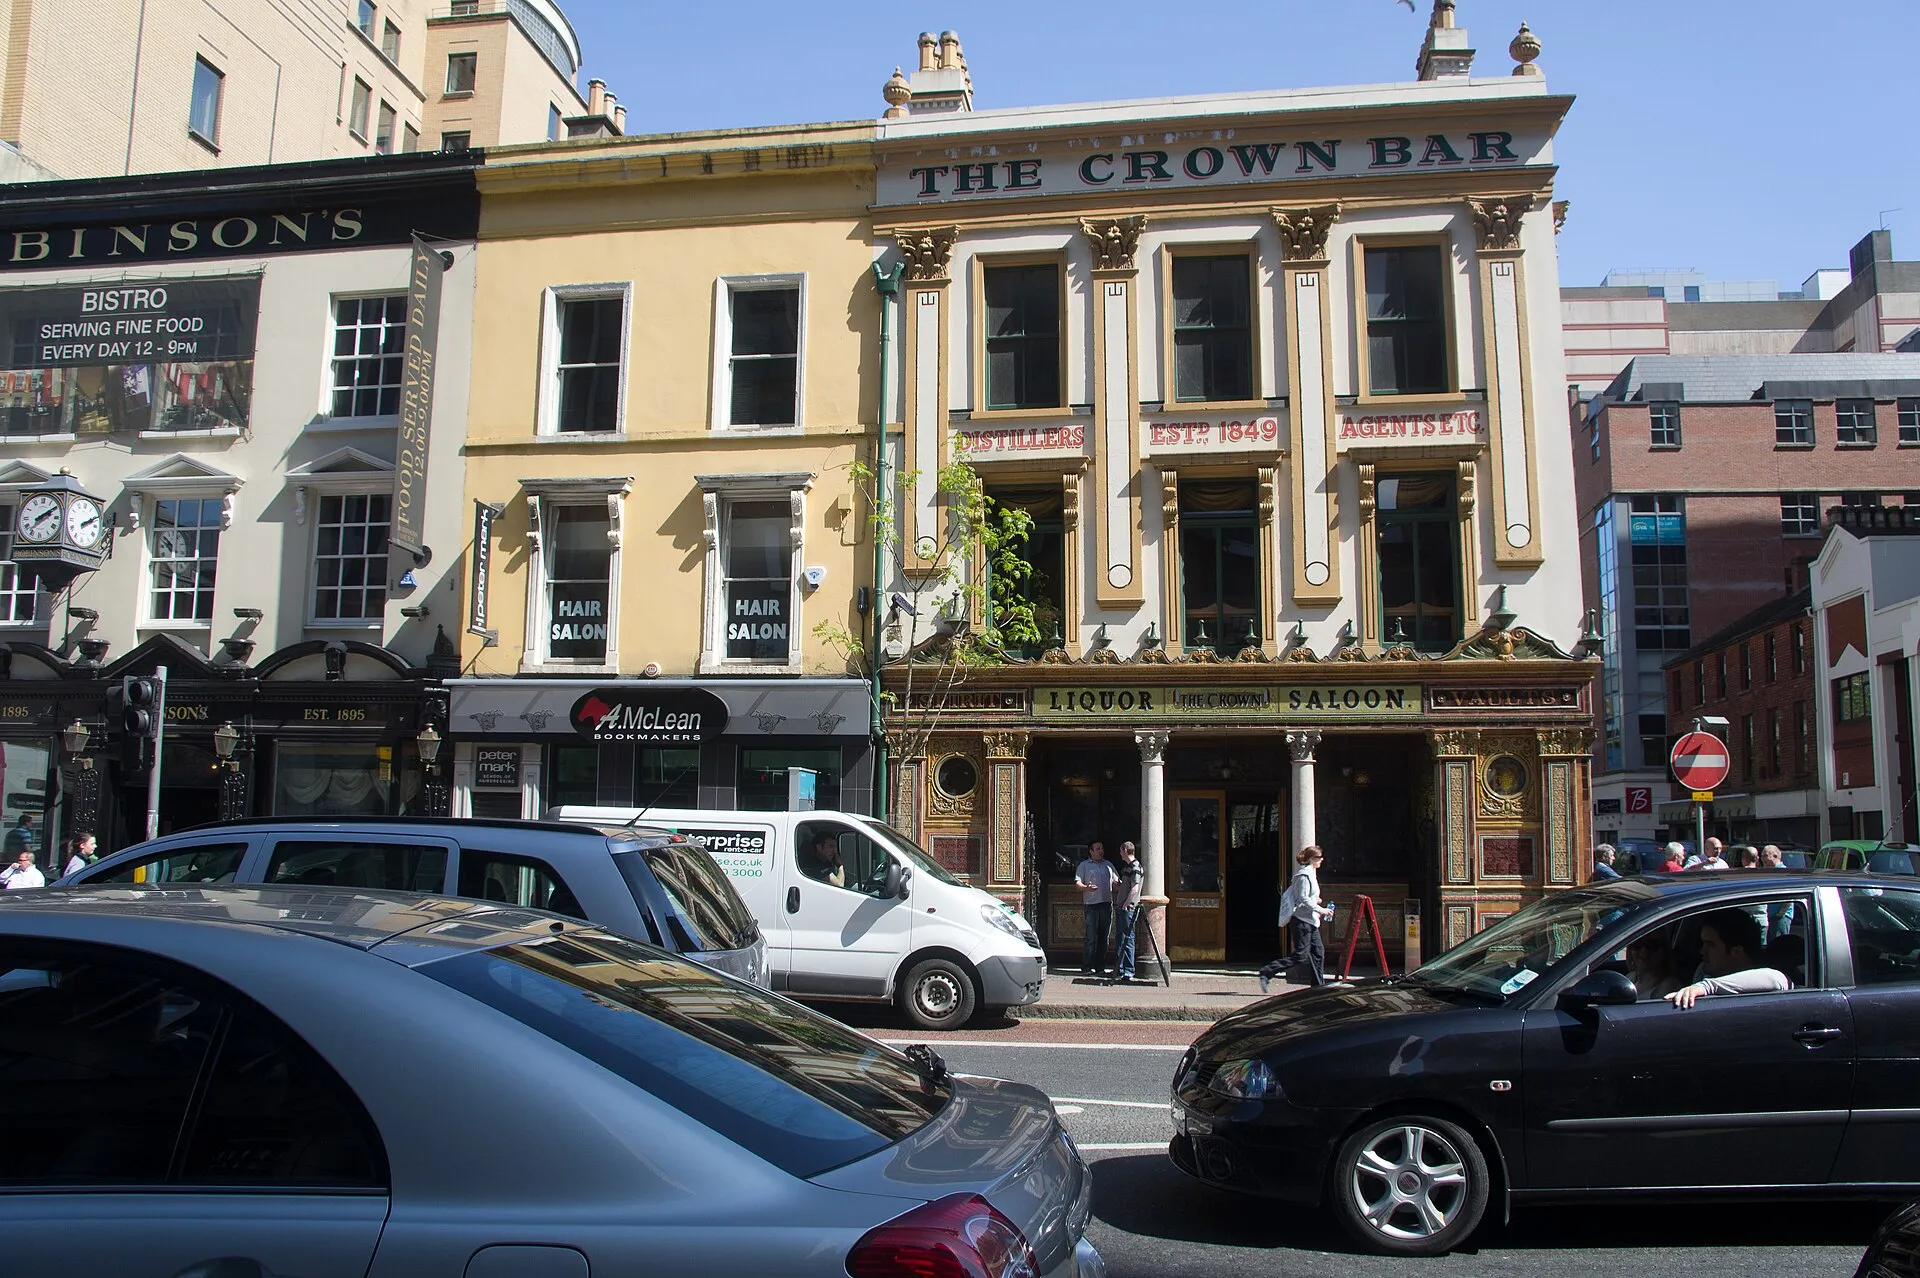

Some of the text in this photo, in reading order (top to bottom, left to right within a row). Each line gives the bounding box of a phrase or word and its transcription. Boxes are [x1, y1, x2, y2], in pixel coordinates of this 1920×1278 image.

[909, 131, 1519, 198] THE CROWN BAR
[8, 208, 363, 262] BINSON'S
[412, 246, 430, 329] DAILY
[82, 287, 168, 312] BISTRO
[40, 317, 204, 339] SERVING FINE FOOD
[42, 343, 94, 360] EVERY
[98, 342, 130, 357] DAY
[135, 341, 152, 355] 12
[168, 340, 198, 354] 9PM
[402, 334, 423, 443] SERVED
[1219, 416, 1278, 443] 1849
[1340, 412, 1436, 440] AGENTS
[960, 424, 1085, 453] DISTILLERS
[398, 449, 415, 525] FOOD
[477, 508, 489, 617] peter mark
[558, 600, 601, 617] HAIR
[735, 599, 780, 616] HAIR
[551, 623, 607, 640] SALON
[728, 622, 787, 640] SALON
[1049, 690, 1154, 712] LIQUOR
[1181, 693, 1263, 708] THE CROWN
[1452, 690, 1556, 706] VAULTS
[2, 705, 29, 718] 1895
[165, 704, 209, 720] SON'S
[303, 708, 365, 721] EST. 1895
[595, 703, 702, 731] A.McLean
[594, 733, 701, 741] BOOKMAKERS
[479, 750, 517, 761] peter
[479, 762, 516, 772] mark
[1631, 789, 1648, 811] B
[732, 868, 763, 878] 3000
